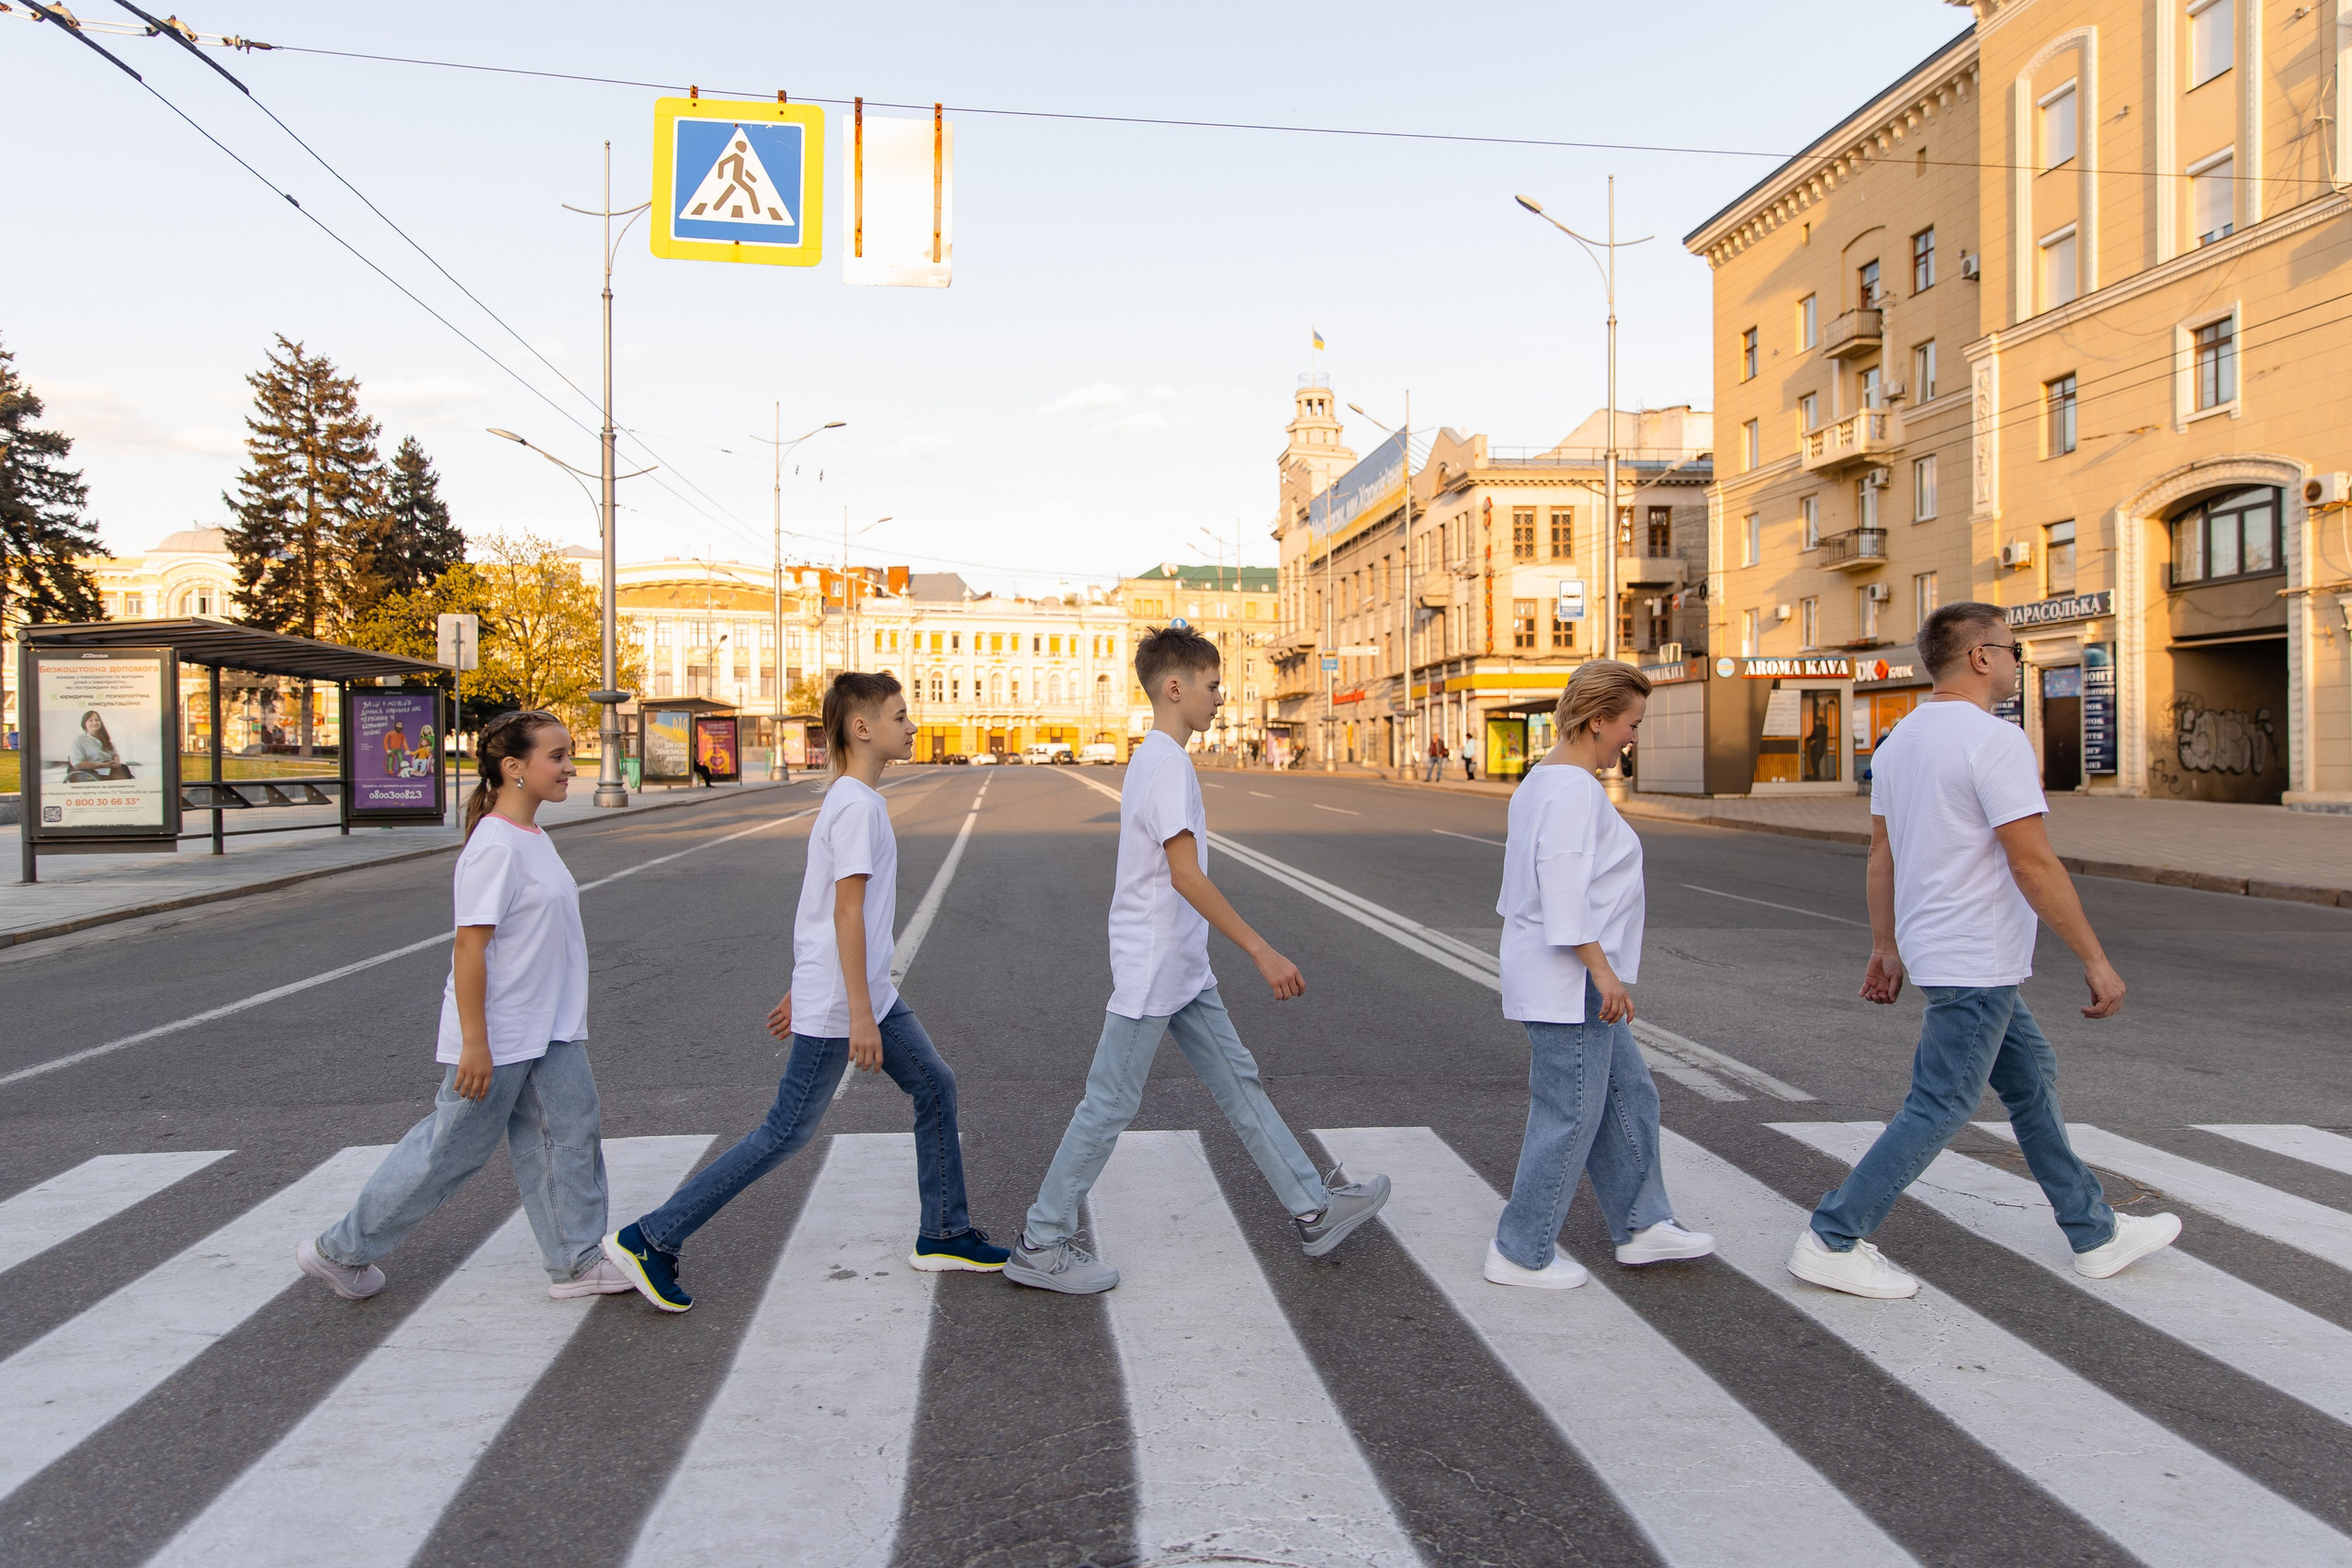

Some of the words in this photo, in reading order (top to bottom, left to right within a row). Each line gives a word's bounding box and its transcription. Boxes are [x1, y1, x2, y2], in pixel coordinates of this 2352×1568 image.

[39, 665, 107, 673] Безкоштовна
[109, 665, 159, 673] допомога
[1745, 660, 1801, 675] AROMA
[1805, 660, 1849, 675] KAVA
[368, 790, 423, 799] 0800300823
[74, 798, 95, 807] 800
